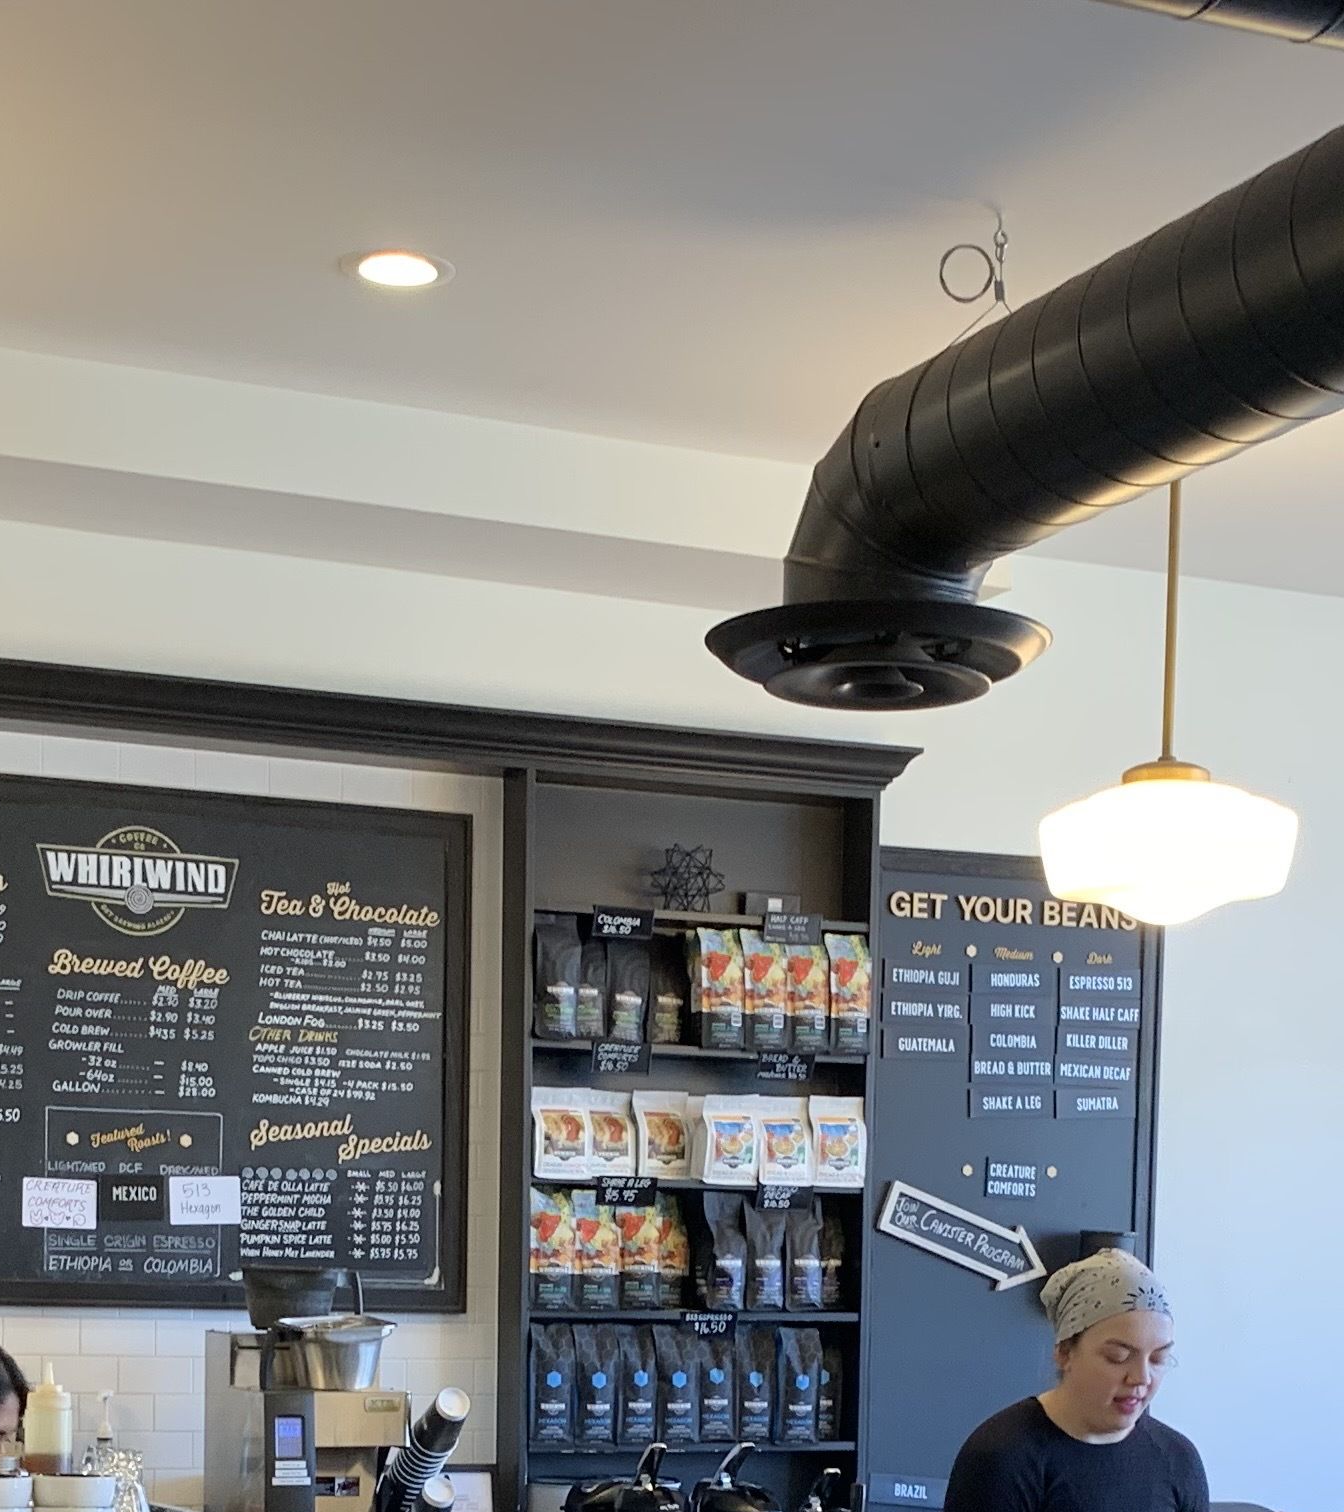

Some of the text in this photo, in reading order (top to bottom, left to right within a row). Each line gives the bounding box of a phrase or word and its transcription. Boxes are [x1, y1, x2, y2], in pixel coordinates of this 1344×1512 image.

[46, 851, 226, 894] WHIRLWIND
[326, 881, 351, 895] Hot
[261, 889, 441, 927] Tea & Chocolate
[890, 890, 948, 920] GET
[957, 894, 1033, 925] YOUR
[911, 940, 1113, 965] Light Medium Dark
[48, 948, 230, 989] Brewed Coffee
[892, 968, 960, 986] ETHIOPIA GUJI
[990, 973, 1040, 988] HONDURAS
[1069, 975, 1133, 991] ESPRESSO 513
[57, 988, 121, 1004] DRIP COFFEE
[55, 1005, 112, 1019] POUR OVER
[891, 1001, 963, 1020] ETHIOPIA YIRG.
[990, 1003, 1036, 1019] HIGH KICK
[1060, 1007, 1140, 1023] SHAKE HALF CAFF
[258, 1012, 301, 1026] LONDON
[52, 1022, 110, 1037] COLD BREW
[48, 1040, 124, 1053] GROWLER FILL
[898, 1037, 956, 1053] GUATEMALA
[989, 1033, 1037, 1049] COLOMBIA
[1066, 1033, 1129, 1050] KILLER DILLER
[974, 1061, 1051, 1076] BREAD & BUTTER
[1060, 1063, 1132, 1081] MEXICAN DECAF
[52, 1081, 101, 1093] GALLON
[982, 1095, 1042, 1110] SHAKE A LEG
[1076, 1097, 1119, 1112] SUMATRA
[90, 1123, 145, 1148] Featured
[250, 1114, 354, 1150] Seasonal
[127, 1130, 172, 1152] Roasts!
[338, 1130, 432, 1164] Specials
[989, 1163, 1036, 1180] CREATURE
[112, 1185, 156, 1201] MEXICO
[182, 1182, 211, 1198] 513
[987, 1180, 1036, 1197] COMFORTS
[180, 1202, 222, 1218] Hexagon
[48, 1257, 213, 1274] ETHIOPIA COLOMBIA
[894, 1483, 928, 1500] BRAZIL
